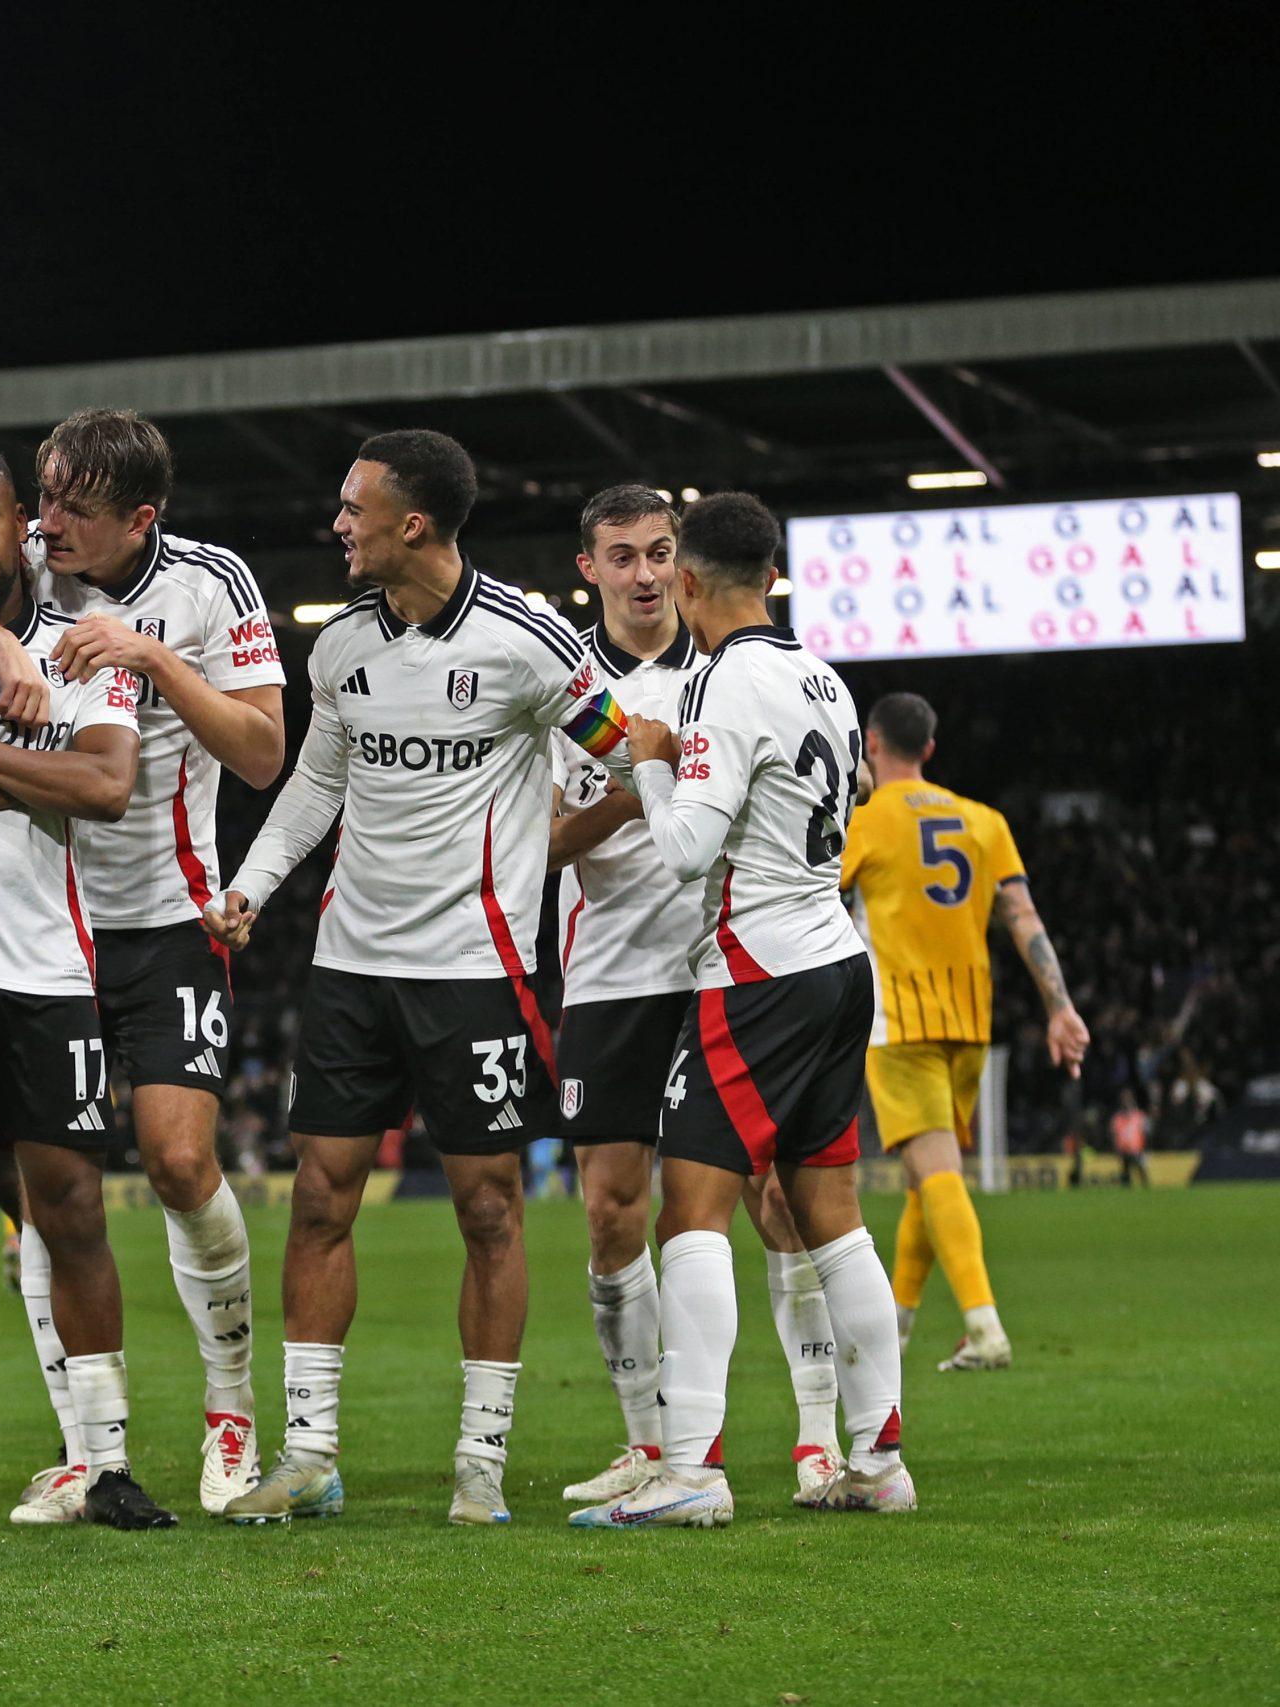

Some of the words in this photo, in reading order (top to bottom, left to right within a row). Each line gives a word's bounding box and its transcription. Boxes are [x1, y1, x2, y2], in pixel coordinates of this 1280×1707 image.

[360, 732, 495, 773] SBOTOP
[677, 758, 711, 782] eds
[680, 732, 710, 756] eb
[919, 817, 973, 906] 5
[176, 987, 228, 1048] 16
[68, 1038, 107, 1101] 17
[471, 1034, 527, 1103] 33
